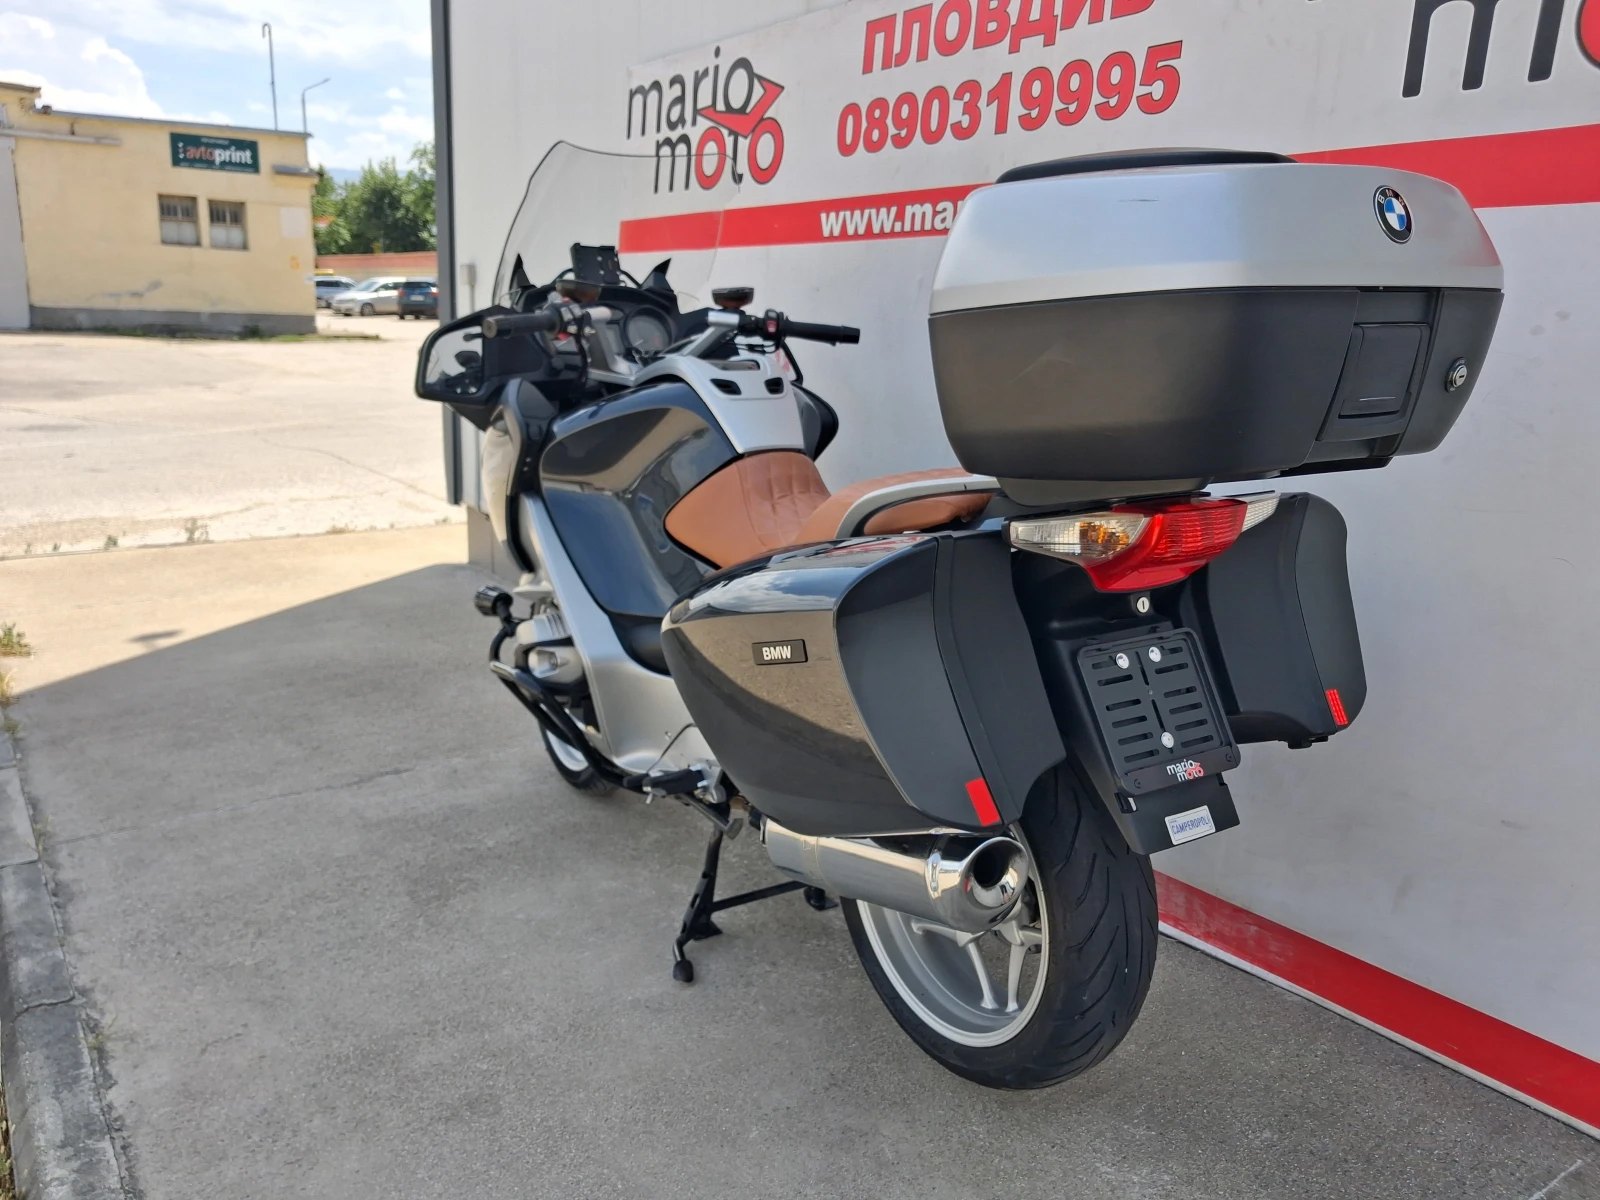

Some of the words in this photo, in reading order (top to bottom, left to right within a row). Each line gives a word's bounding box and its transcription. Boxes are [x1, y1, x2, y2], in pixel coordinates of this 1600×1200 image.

[626, 45, 755, 140] mario
[837, 40, 1183, 157] 0890319995
[186, 146, 253, 165] avtoprint
[654, 117, 784, 194] moto
[762, 645, 791, 660] BMW
[1166, 758, 1195, 776] mario
[1176, 766, 1204, 782] moto
